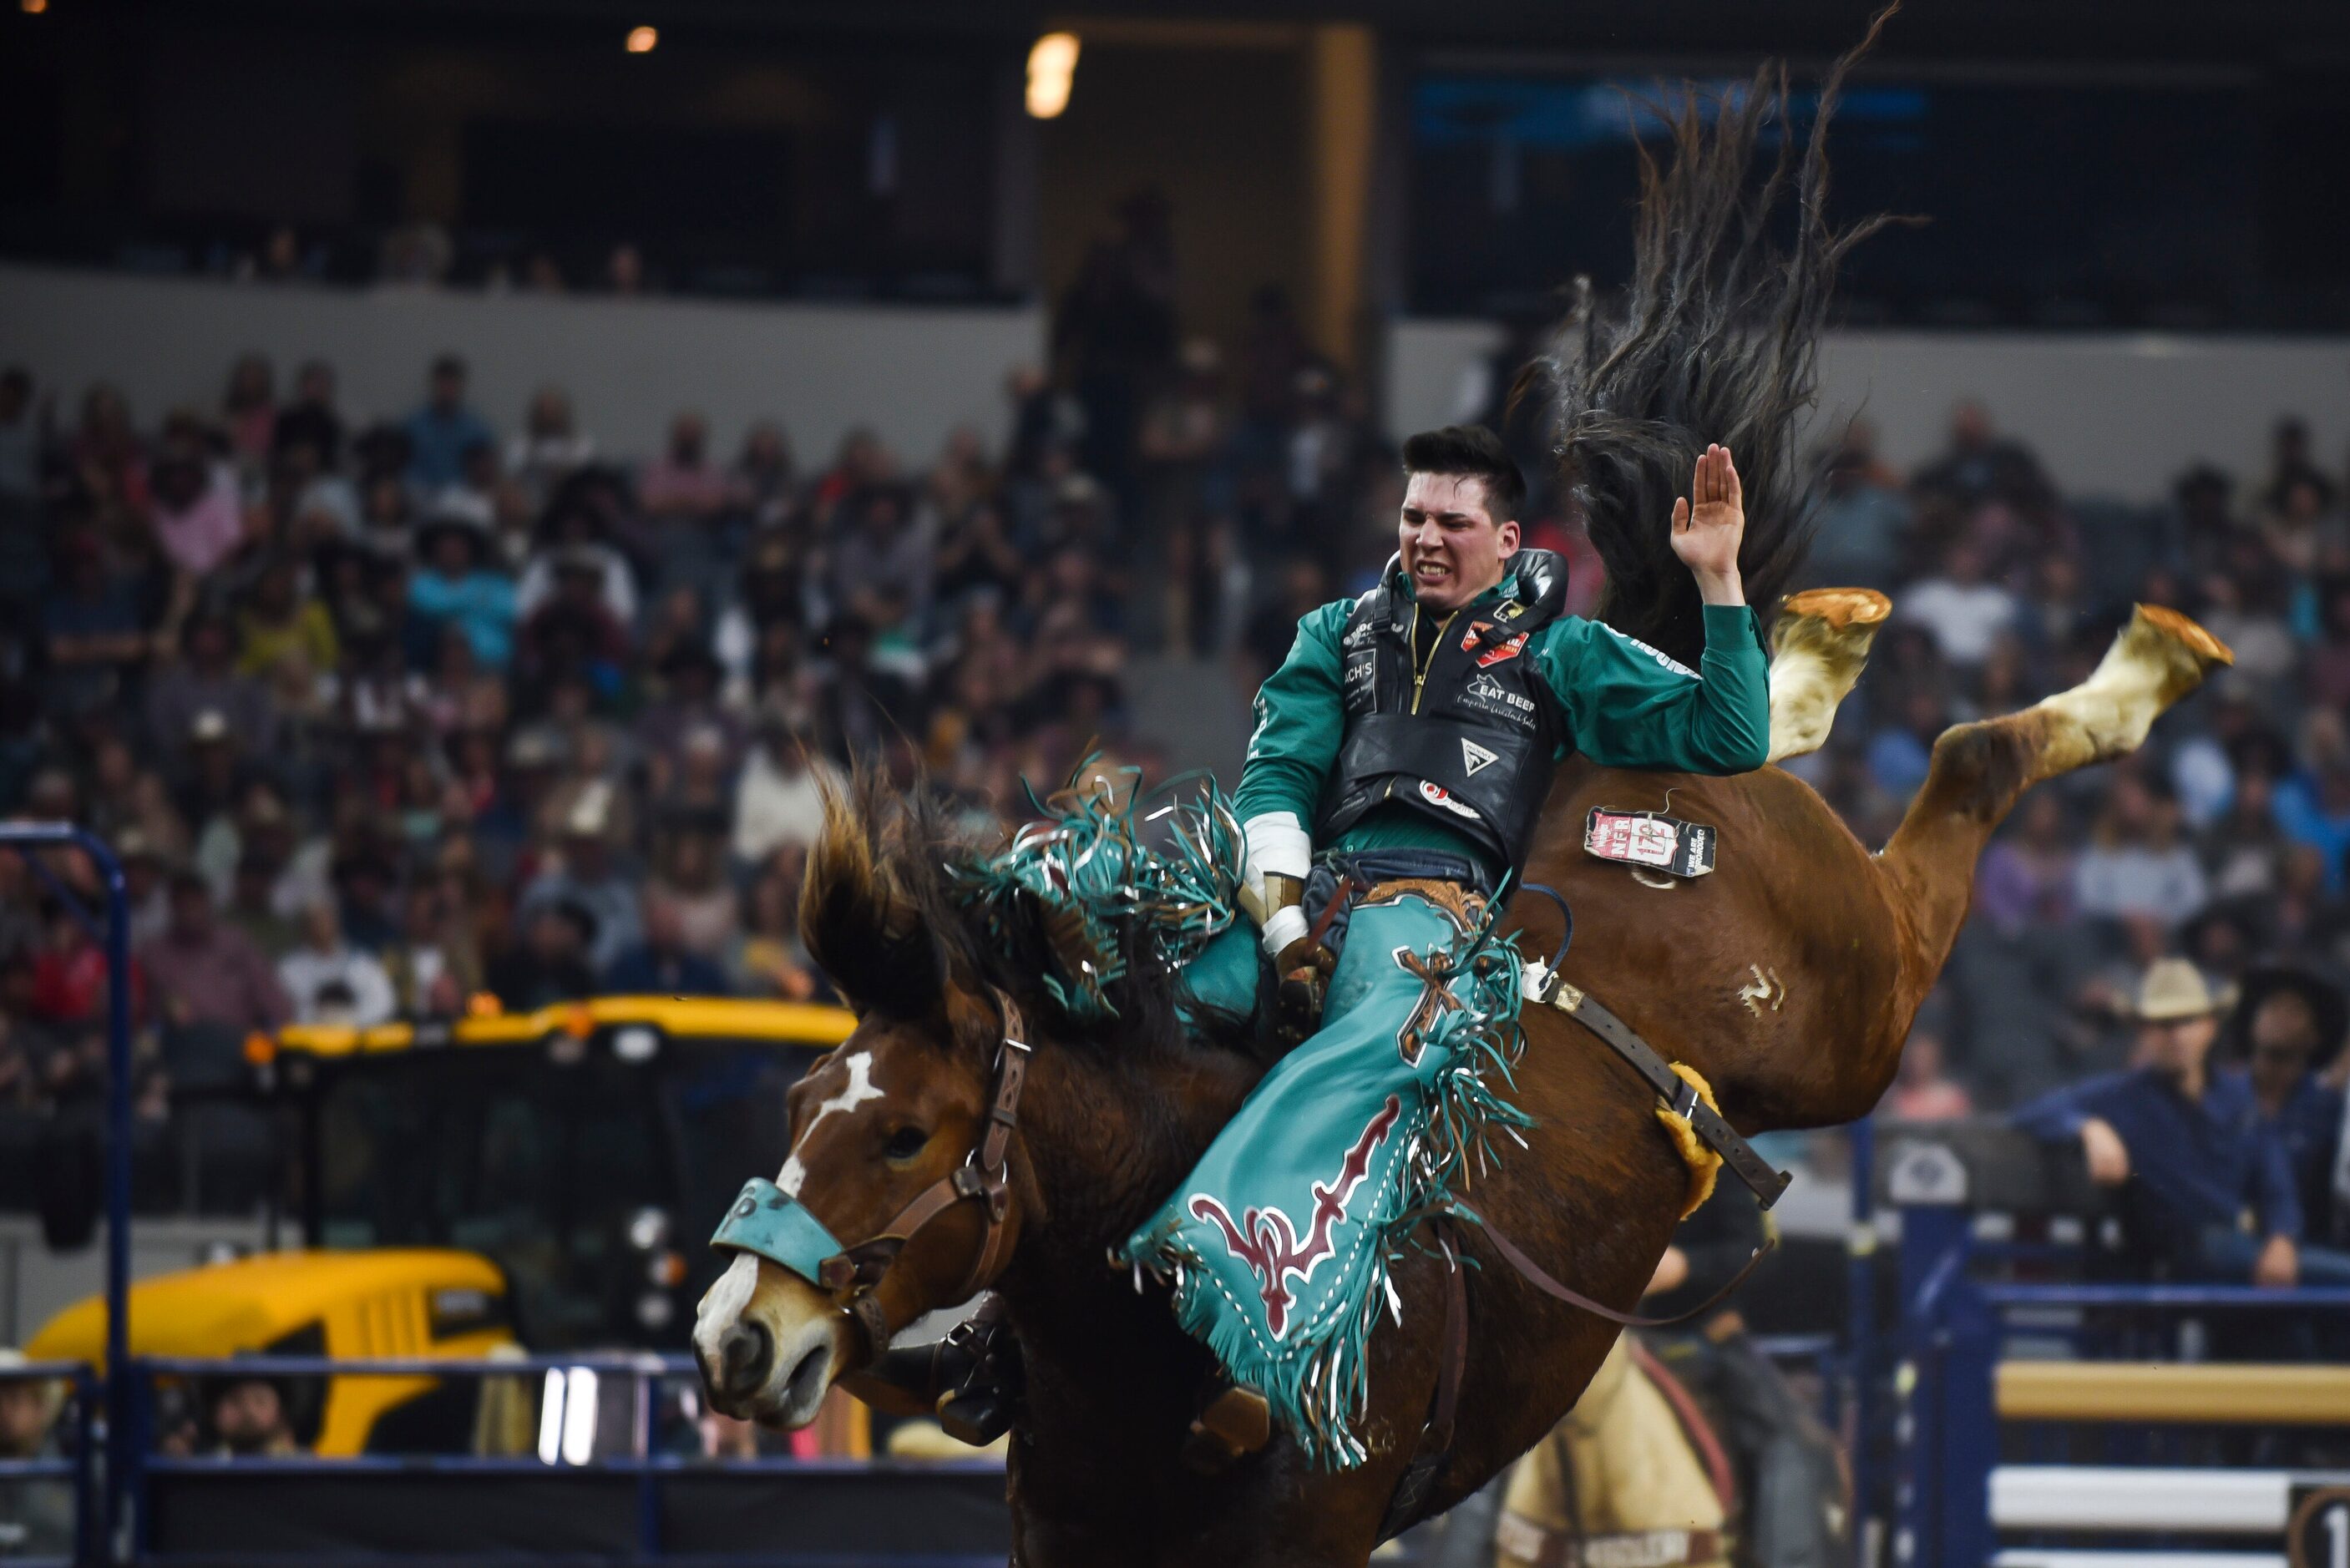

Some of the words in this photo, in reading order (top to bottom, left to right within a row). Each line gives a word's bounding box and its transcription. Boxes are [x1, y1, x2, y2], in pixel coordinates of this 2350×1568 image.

[1479, 685, 1505, 701] EAT
[1611, 819, 1630, 856] NFR
[1689, 837, 1698, 855] ARE
[1687, 853, 1696, 868] WE
